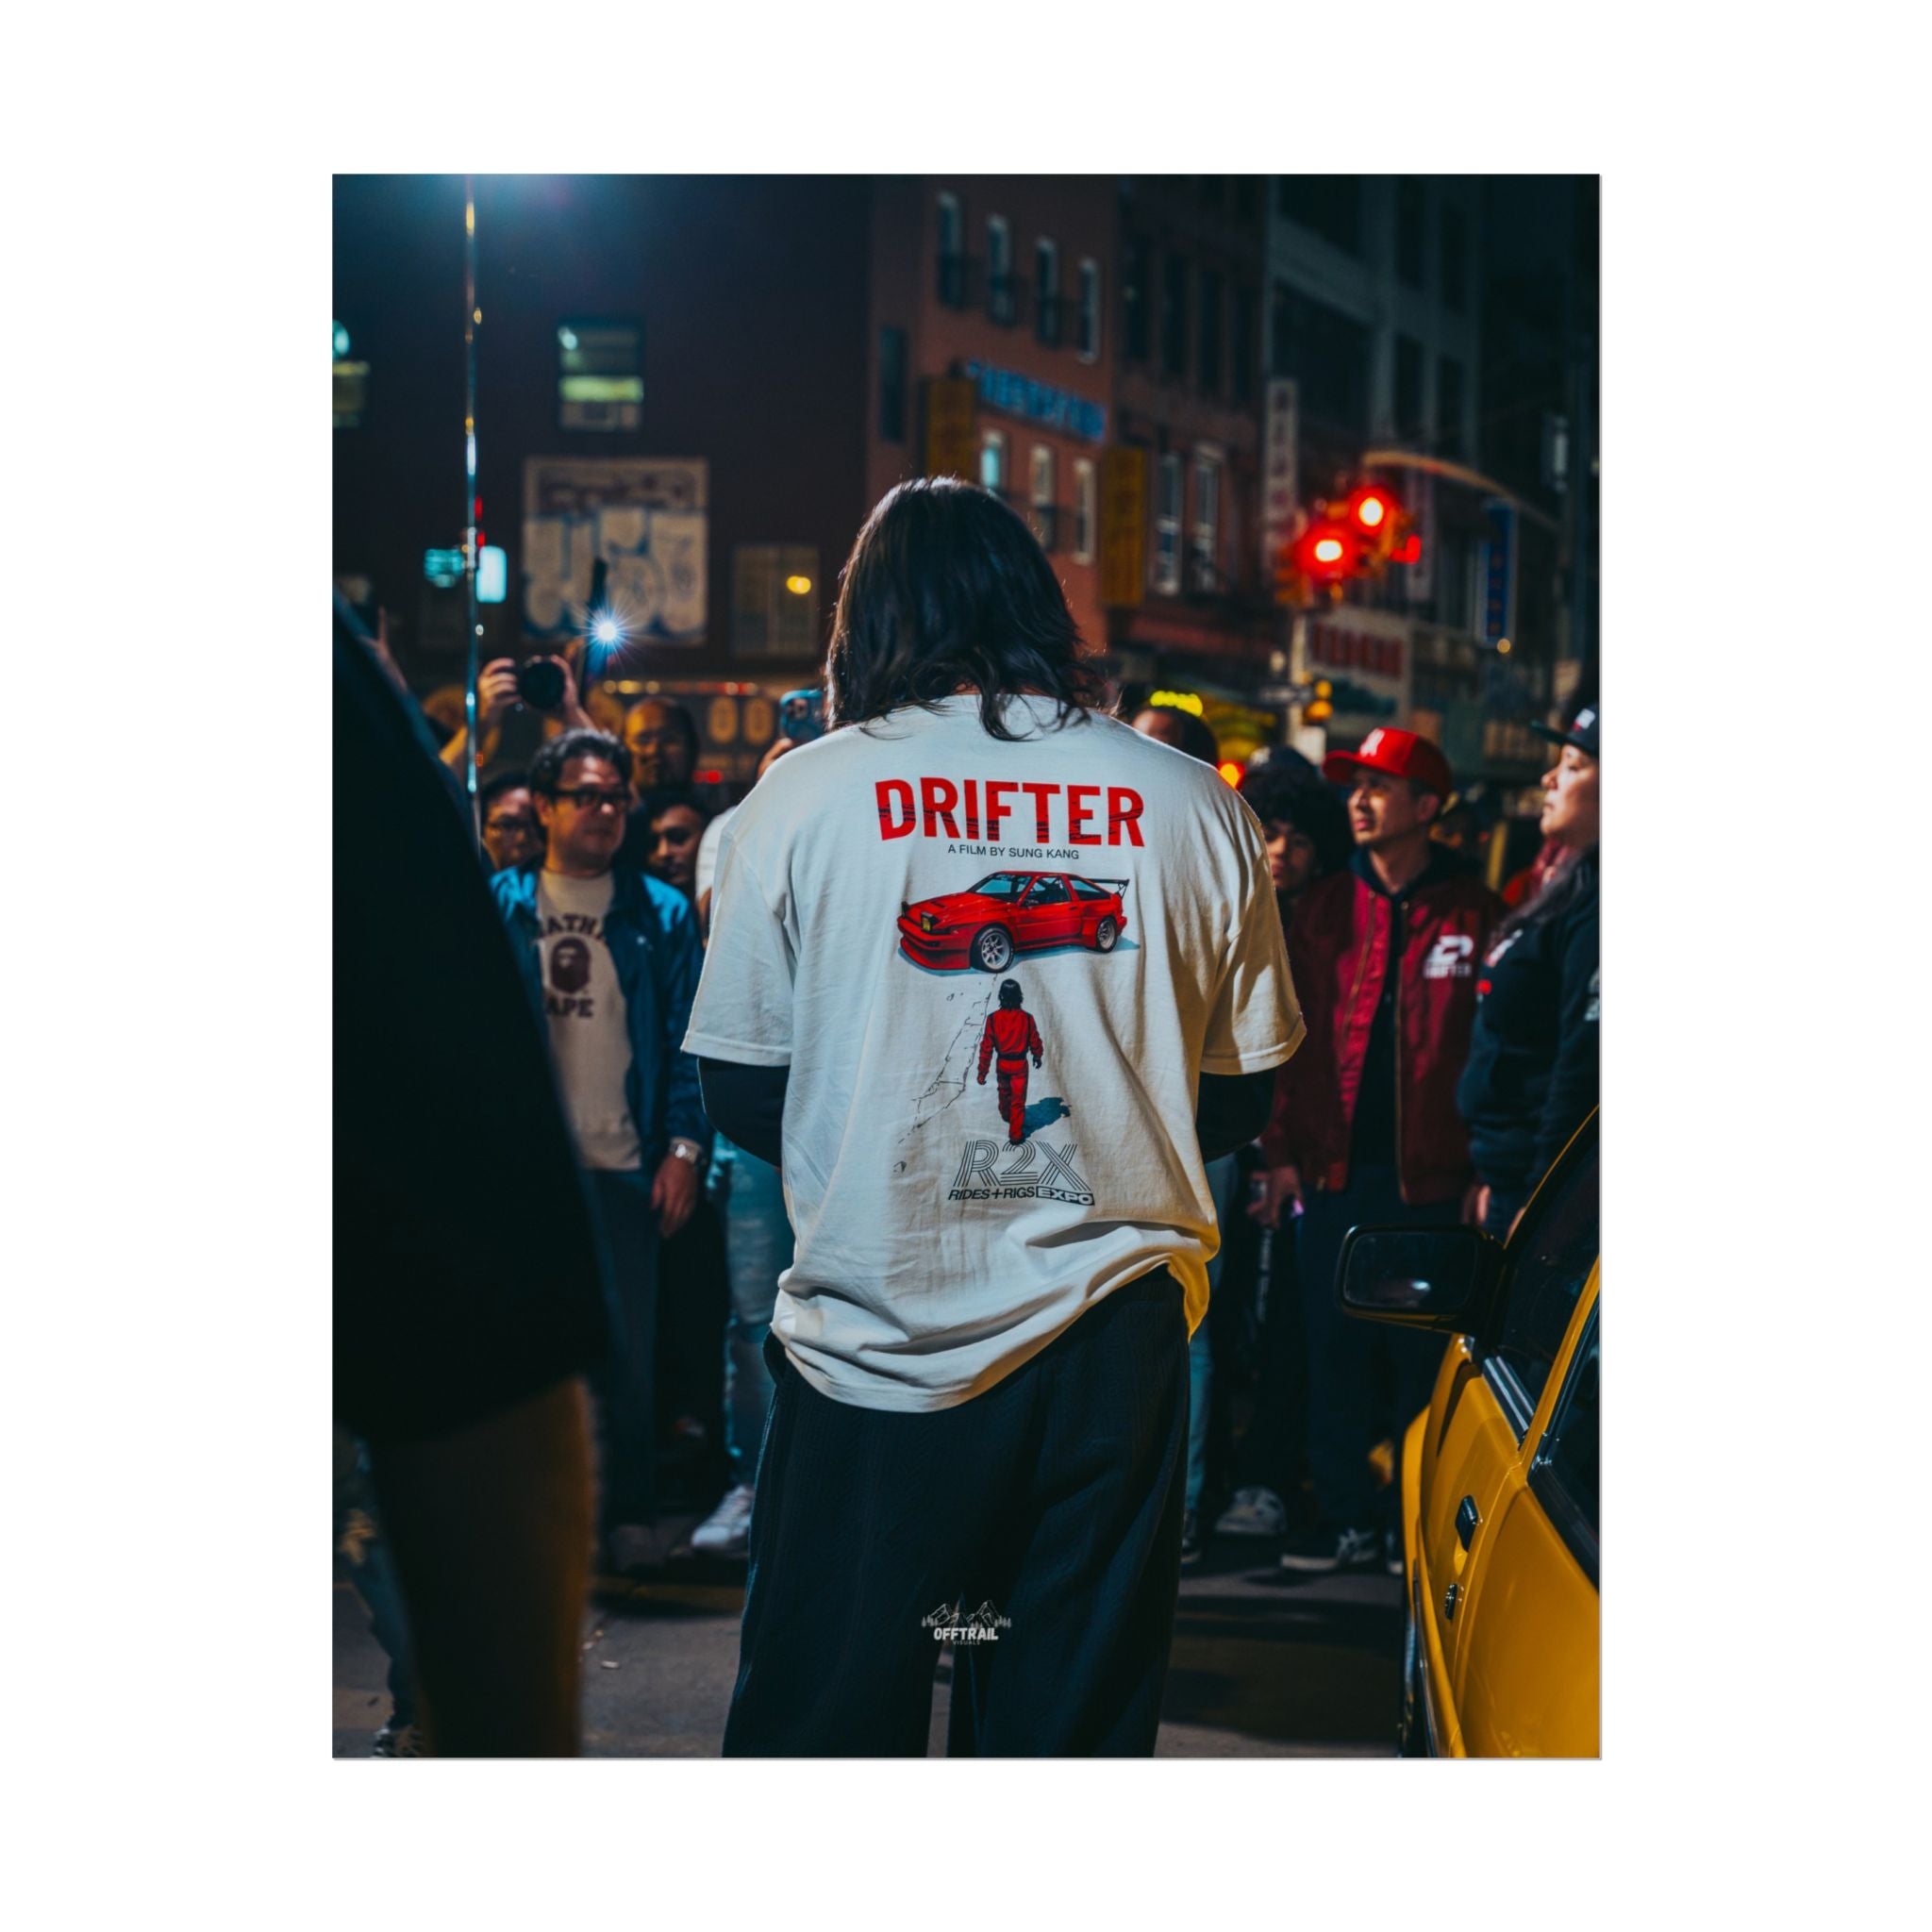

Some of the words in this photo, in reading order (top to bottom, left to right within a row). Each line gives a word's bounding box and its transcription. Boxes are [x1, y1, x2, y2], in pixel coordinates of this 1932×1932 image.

[875, 777, 1144, 847] DRIFTER
[948, 844, 957, 854] A
[959, 844, 987, 856] FILM
[990, 846, 1006, 857] BY
[1008, 848, 1042, 858] SUNG
[1046, 850, 1079, 860] KANG
[953, 1140, 1092, 1191] R2X
[1038, 1187, 1094, 1206] EXPO
